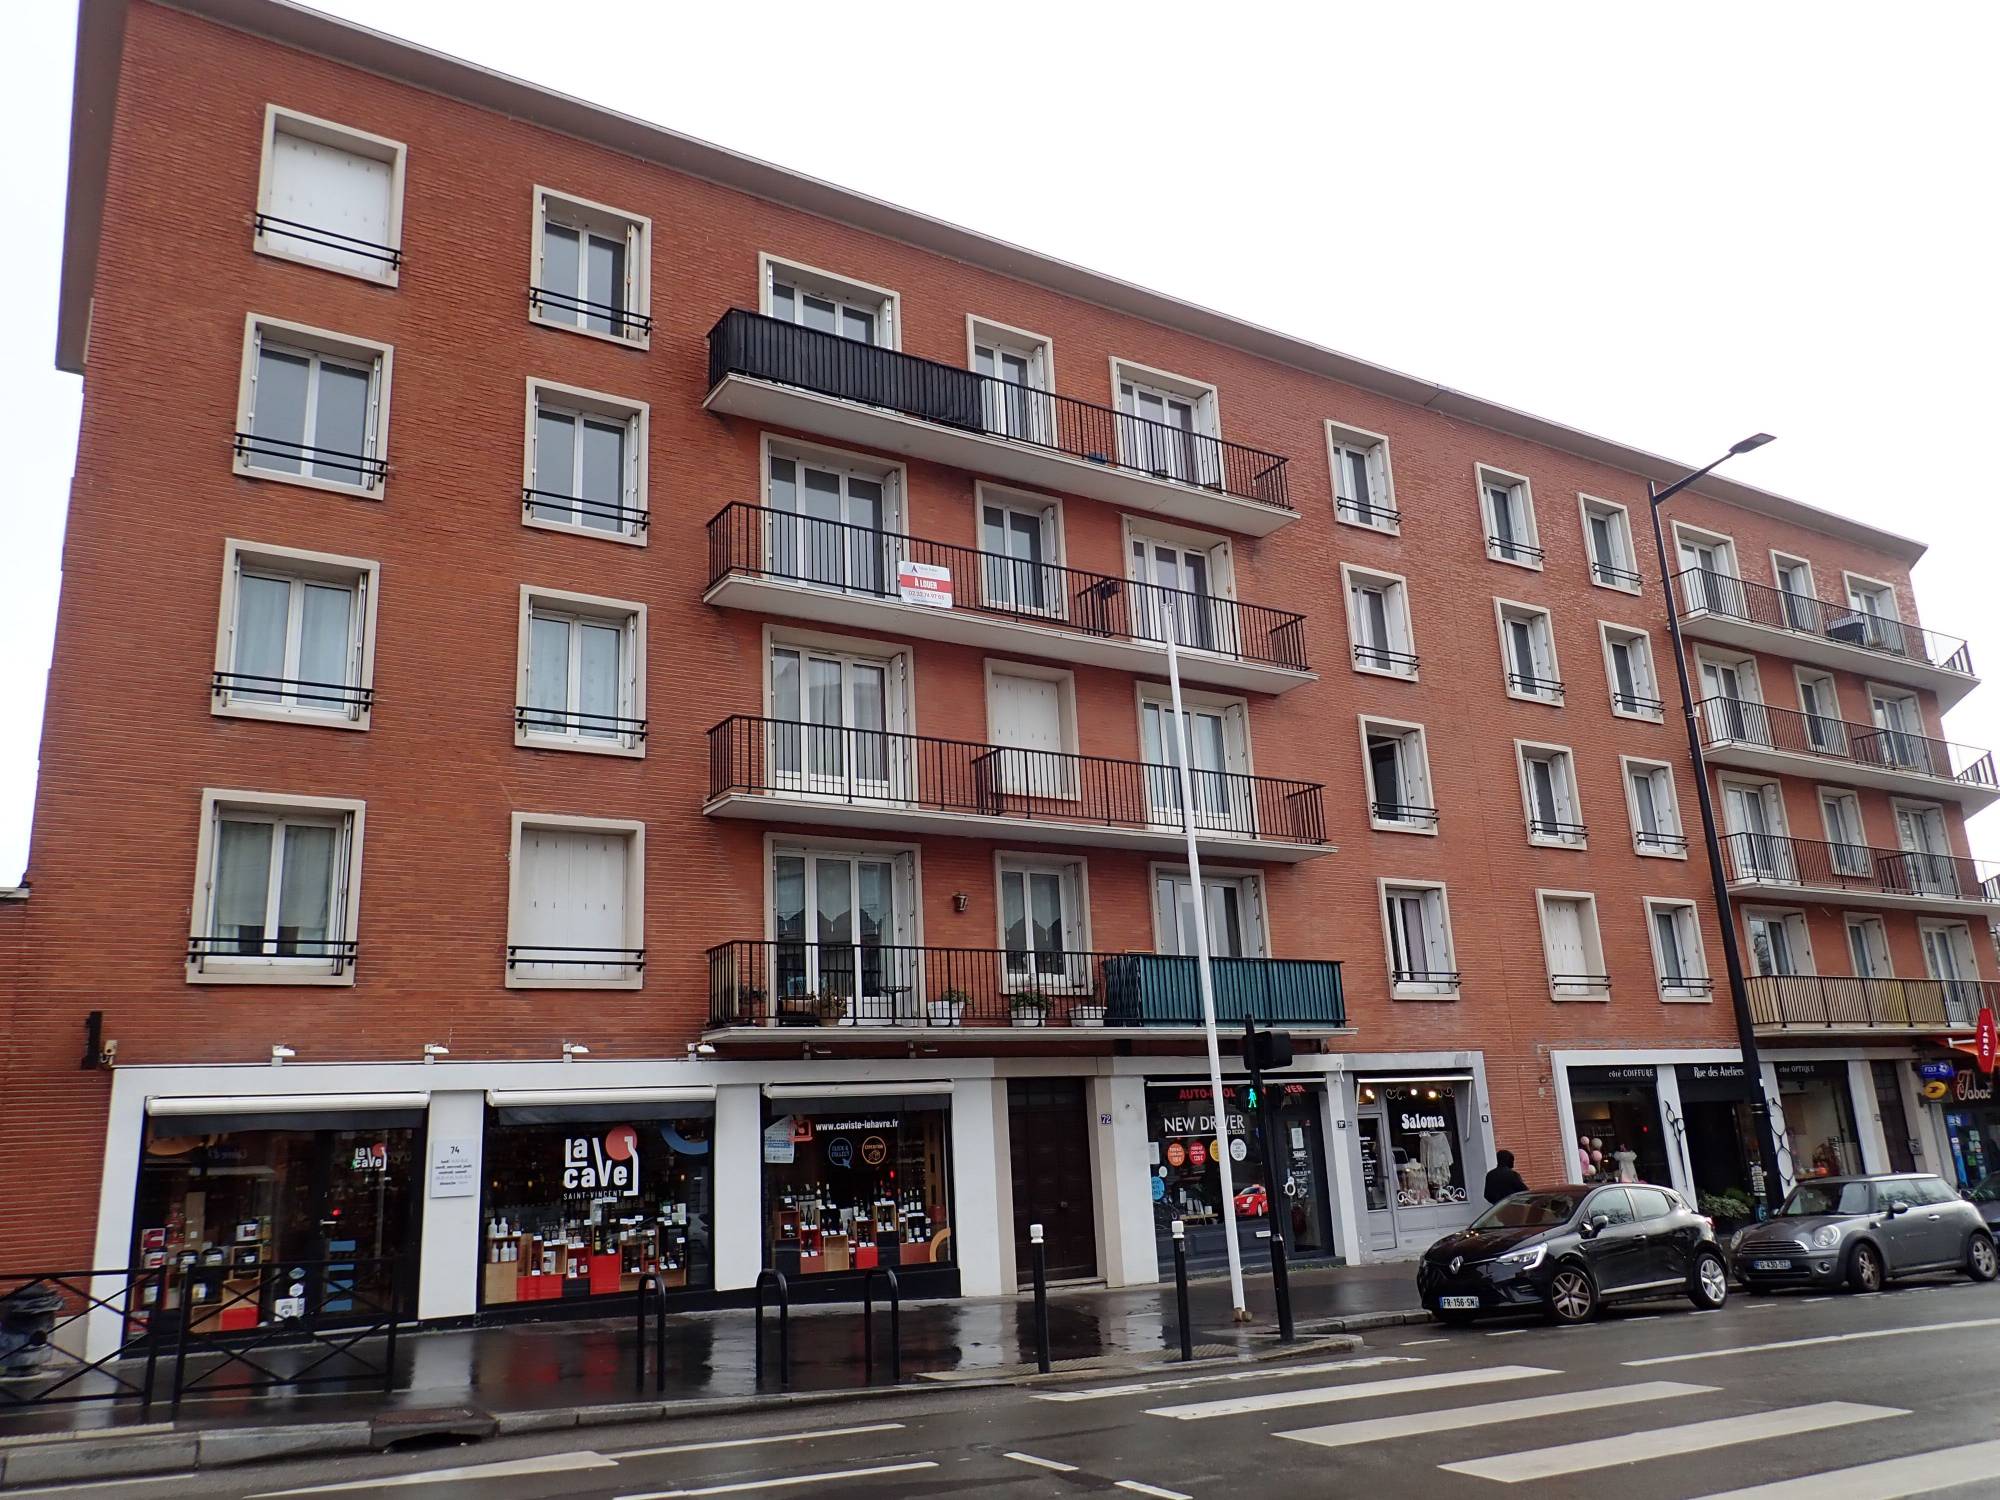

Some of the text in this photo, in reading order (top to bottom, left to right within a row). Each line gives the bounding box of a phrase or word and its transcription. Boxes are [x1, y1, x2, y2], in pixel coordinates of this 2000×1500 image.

[920, 579, 938, 590] LOUER
[1623, 1068, 1654, 1078] COIFFURE
[1693, 1065, 1745, 1079] Rue des Ateliers
[1957, 1069, 1992, 1101] Tabac
[815, 1118, 899, 1132] www.caviste-lehavre.fr
[1101, 1114, 1111, 1124] 72
[1164, 1116, 1196, 1133] NEW
[1401, 1113, 1445, 1130] Saloma
[450, 1145, 460, 1154] 74
[563, 1189, 622, 1201] SAINT-VINCENT
